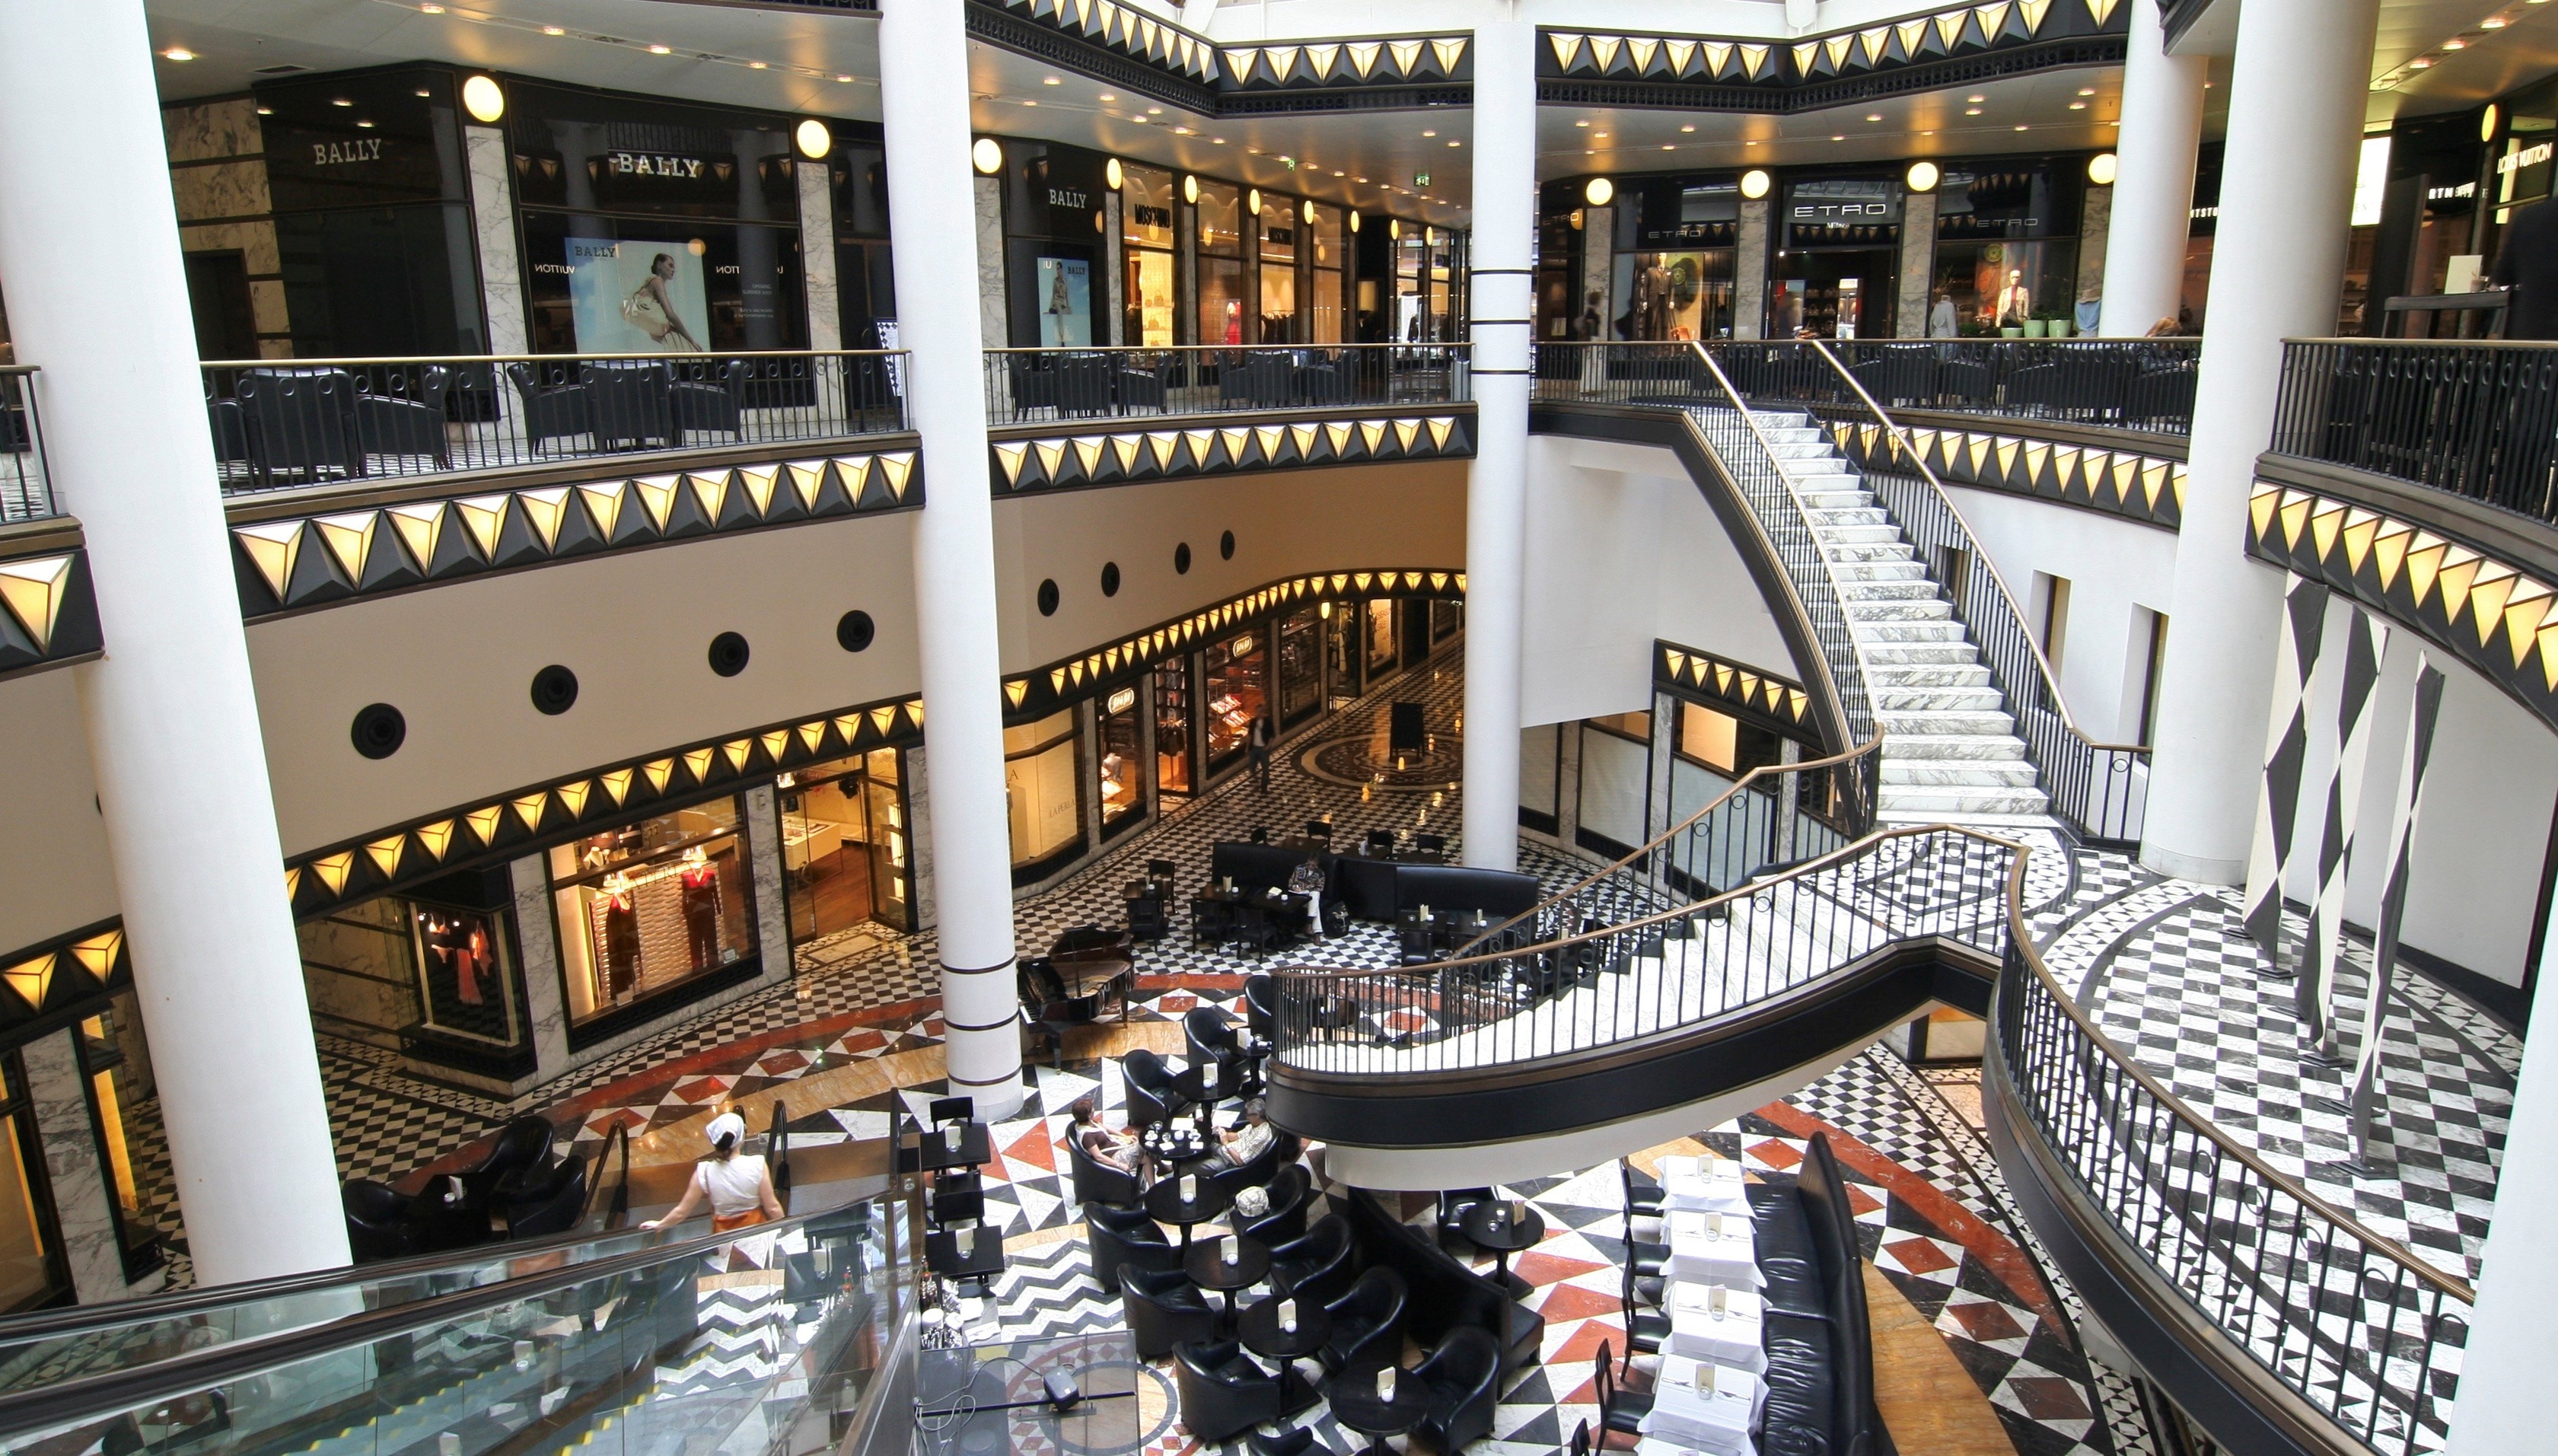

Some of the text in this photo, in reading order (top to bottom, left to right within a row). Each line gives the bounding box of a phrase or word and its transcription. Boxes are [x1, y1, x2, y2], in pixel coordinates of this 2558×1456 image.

[314, 139, 381, 165] BALLY
[2497, 142, 2553, 174] LOUIS VUITTON
[617, 153, 699, 178] BALLY
[1049, 189, 1086, 209] BALLY
[1135, 204, 1170, 228] MOSCHINO
[1795, 204, 1886, 217] ETRO
[1977, 218, 2038, 228] ETRO
[1649, 230, 1702, 238] ETRO
[575, 246, 615, 257] BALLY
